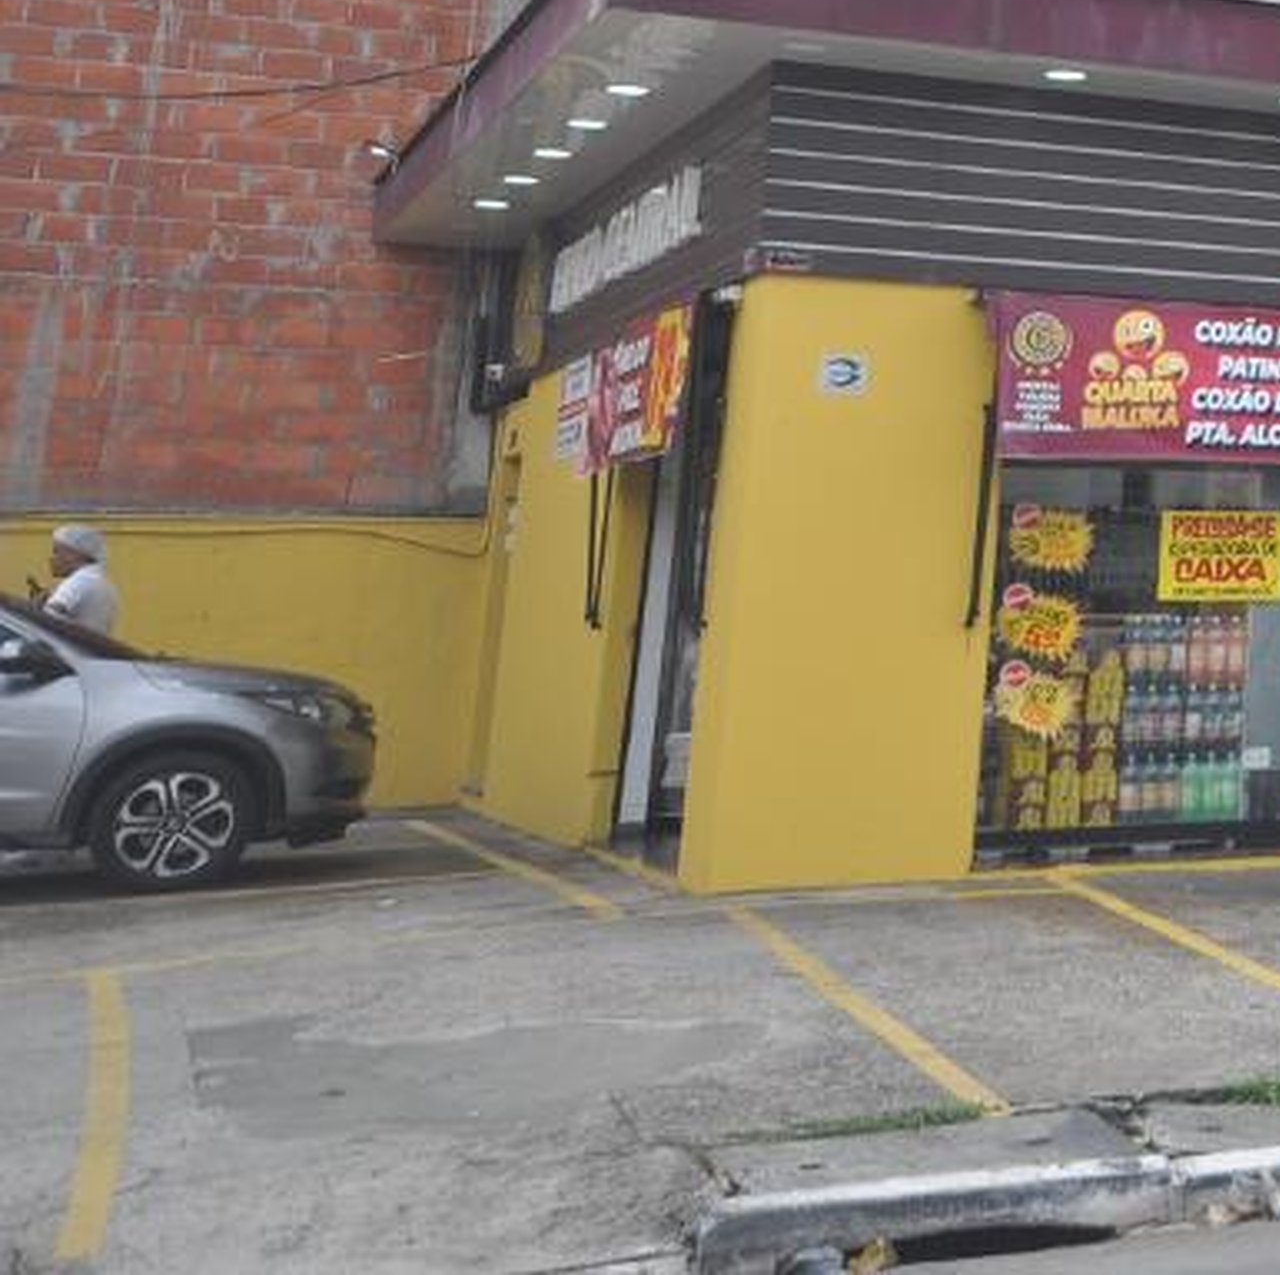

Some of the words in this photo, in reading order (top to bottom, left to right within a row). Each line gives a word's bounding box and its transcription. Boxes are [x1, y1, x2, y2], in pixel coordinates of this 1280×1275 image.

[1194, 317, 1273, 347] COXÃO
[1191, 384, 1270, 412] COXÃO
[1184, 421, 1235, 445] PTA.
[1175, 557, 1266, 583] CAIXA
